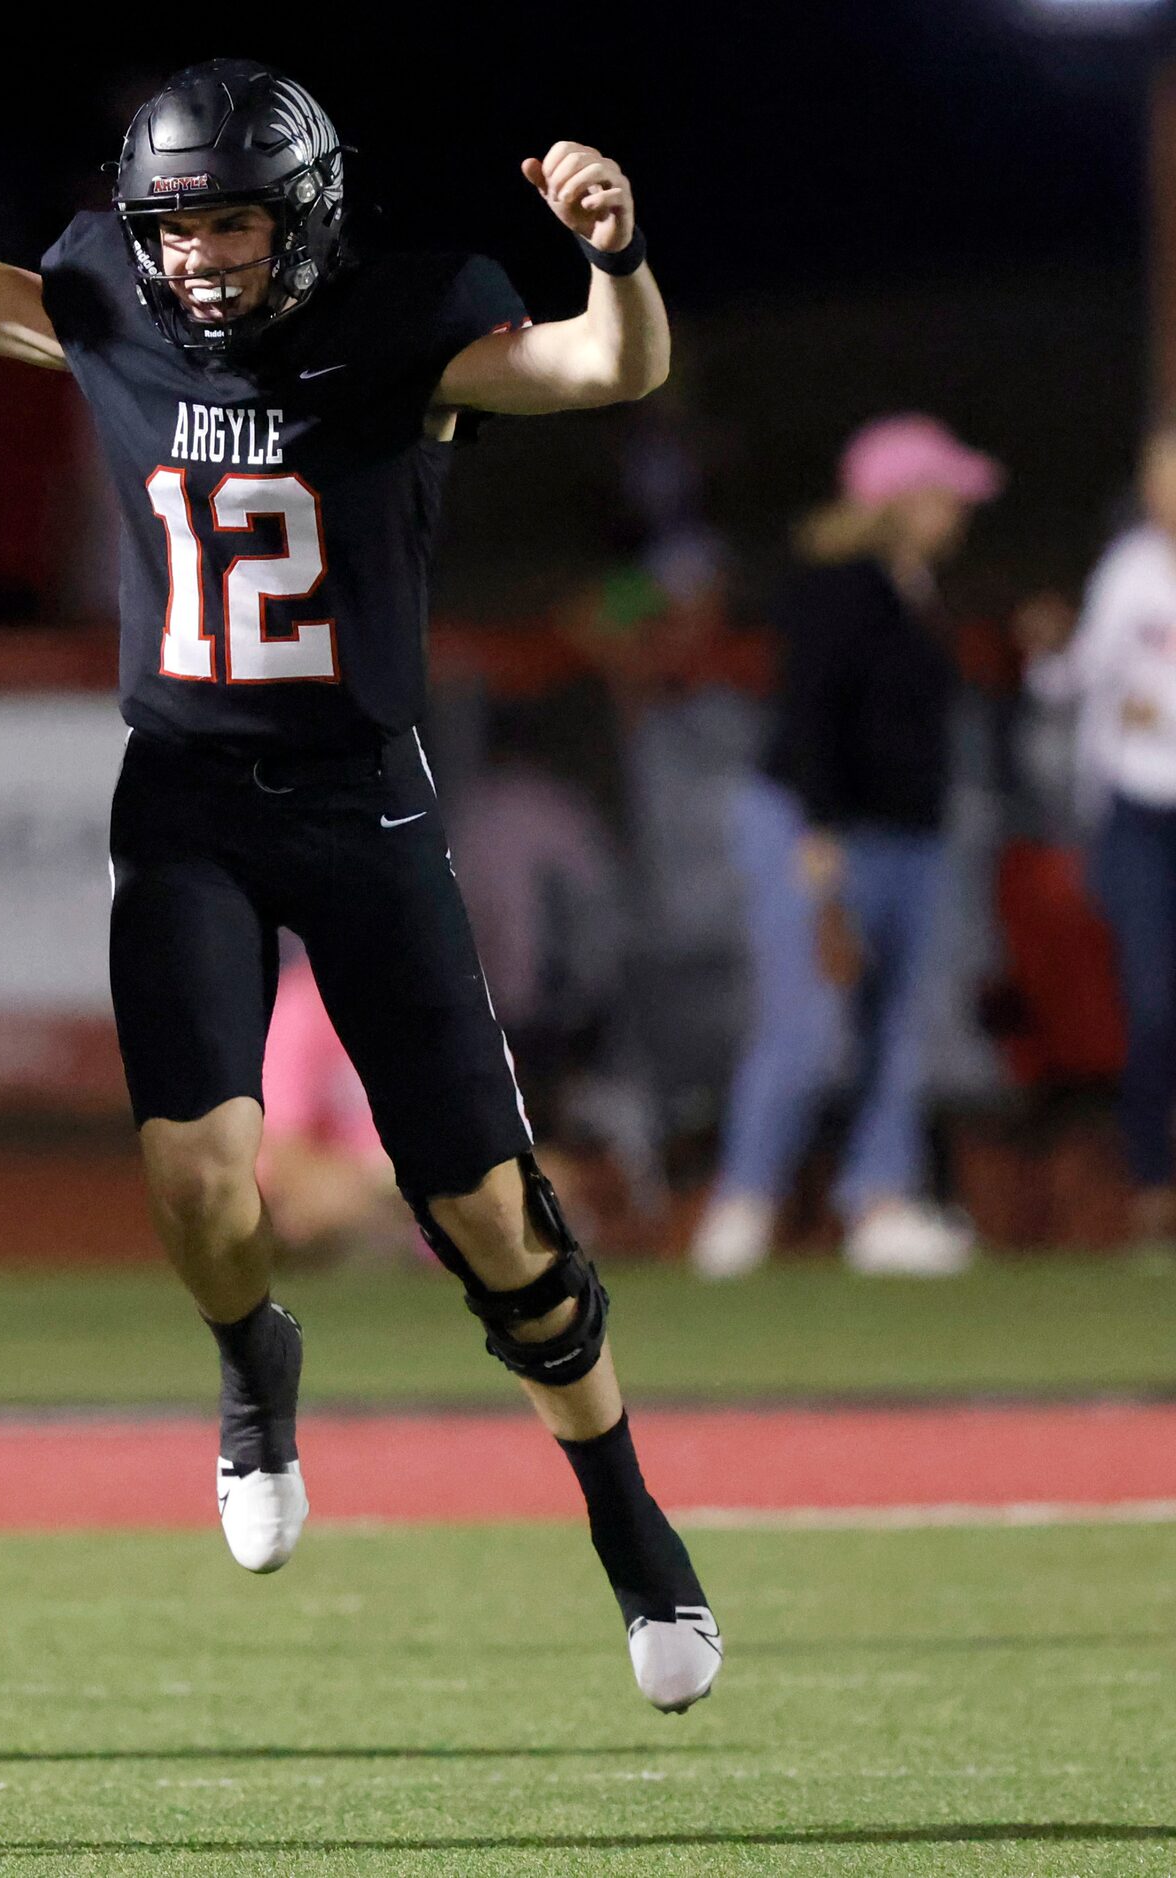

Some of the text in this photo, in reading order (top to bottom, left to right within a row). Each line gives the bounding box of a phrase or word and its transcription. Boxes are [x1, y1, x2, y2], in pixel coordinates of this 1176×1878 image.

[153, 175, 209, 193] ARGYLE
[171, 402, 283, 464] ARGYLE
[145, 465, 341, 685] 12
